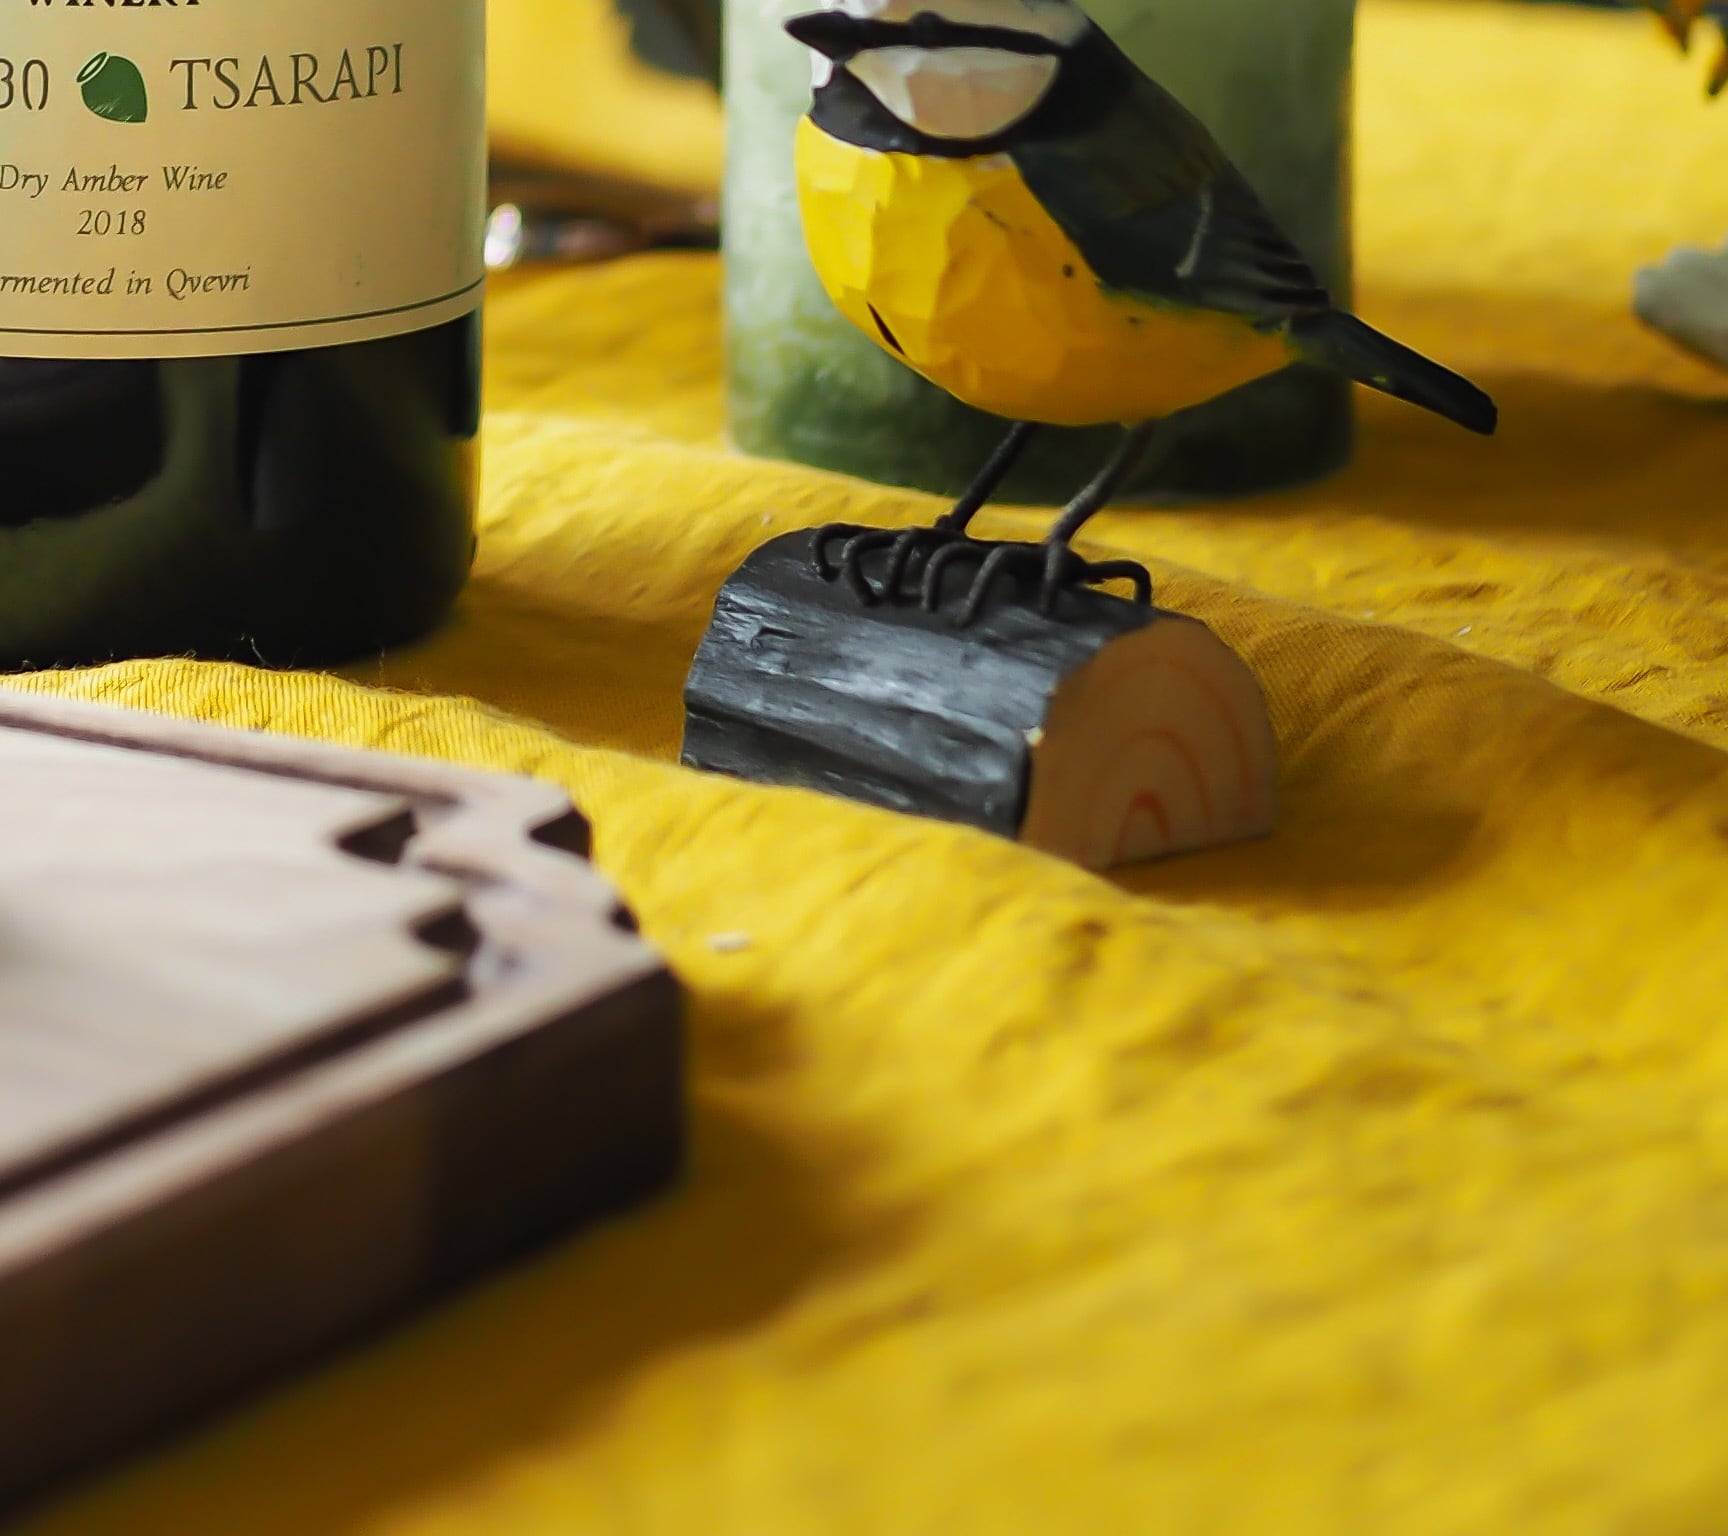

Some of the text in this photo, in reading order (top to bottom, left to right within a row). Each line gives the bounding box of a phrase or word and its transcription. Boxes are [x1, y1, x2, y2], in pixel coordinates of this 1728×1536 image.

[170, 42, 403, 110] TSARAPI
[61, 164, 149, 193] Amber
[162, 164, 228, 192] Wine
[76, 209, 146, 236] 2018
[127, 268, 153, 295] in
[166, 266, 251, 301] Qvevri
